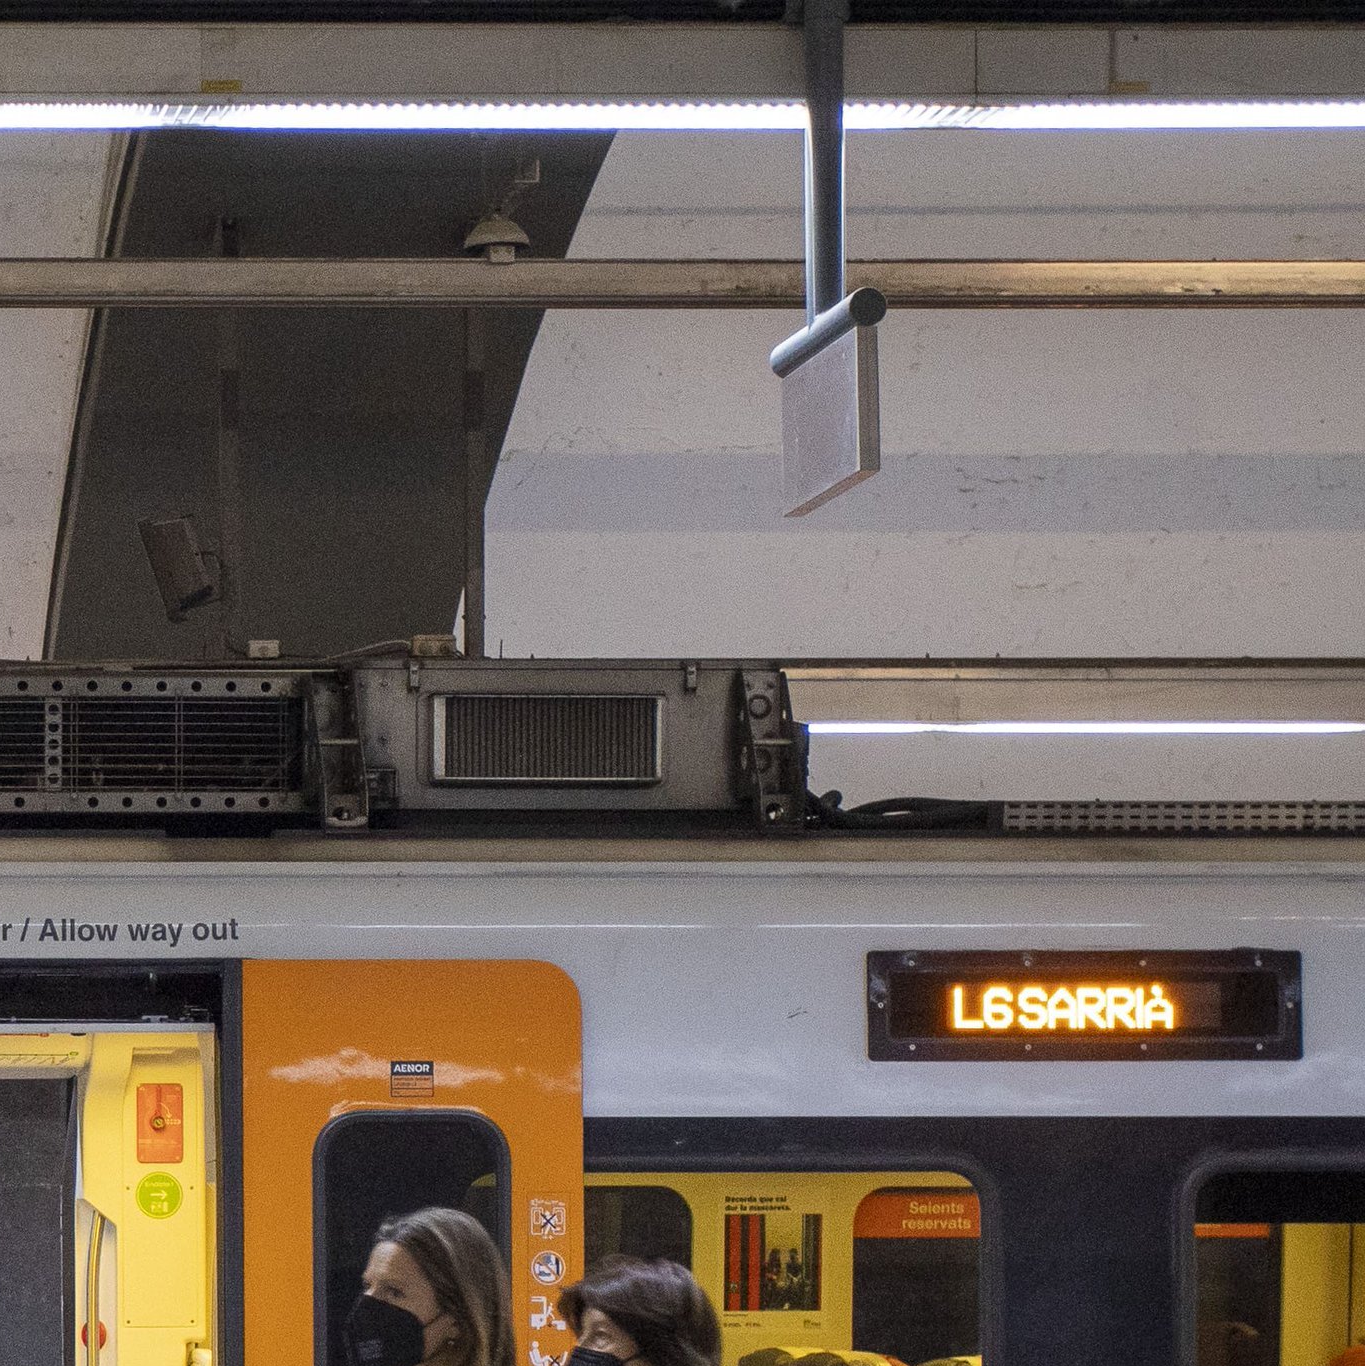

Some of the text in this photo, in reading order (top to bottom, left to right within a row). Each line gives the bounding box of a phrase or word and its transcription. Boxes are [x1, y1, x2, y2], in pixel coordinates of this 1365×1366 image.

[20, 917, 30, 941] /
[39, 917, 118, 941] Allow
[128, 923, 183, 947] way
[192, 918, 239, 941] out
[952, 982, 1175, 1030] L6 SARRIÀ
[394, 1064, 430, 1073] AENOR
[908, 1201, 965, 1214] Seients
[901, 1217, 972, 1230] reservats
